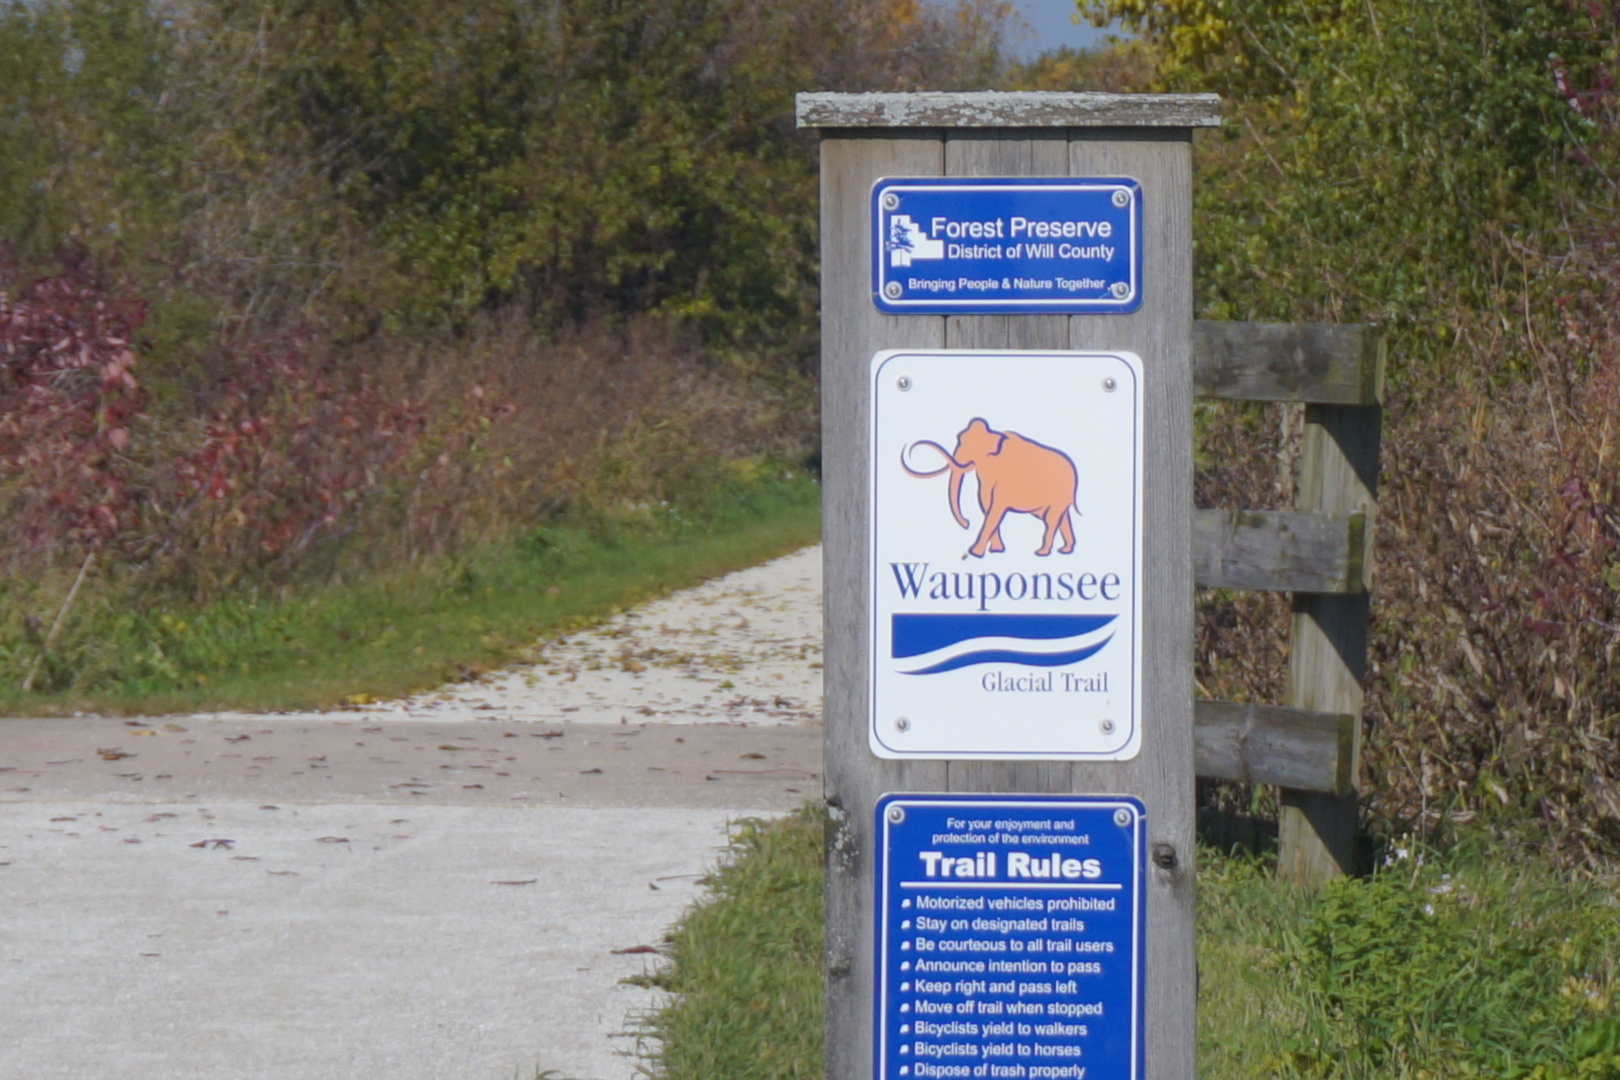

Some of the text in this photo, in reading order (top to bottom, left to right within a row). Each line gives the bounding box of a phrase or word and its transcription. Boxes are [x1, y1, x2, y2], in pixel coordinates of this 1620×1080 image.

[931, 217, 1111, 238] Forest Preserve
[948, 244, 1114, 261] District of Will County
[908, 278, 1105, 291] Bringing People & Nature Together
[889, 562, 1121, 611] Wauponsee
[982, 672, 1108, 692] Glacial Trail
[947, 818, 1074, 832] For your enjoyment and
[932, 833, 1089, 845] protection of the environment
[919, 851, 1101, 878] Trail Rules
[916, 896, 1115, 913] Motorized vehicles prohibited
[916, 917, 1084, 934] Stay on designated trails
[916, 938, 1113, 952] Be courteous to all trail users
[915, 959, 1101, 976] Announce intention to pass
[915, 980, 1077, 996] Keep right and pass left
[915, 1000, 1103, 1017] Move off trail when stopped
[915, 1021, 1087, 1038] Bicyclists yield to walkers
[914, 1042, 1081, 1058] Bicyclists yield to horses
[914, 1063, 1085, 1080] Dispose of trash properly
